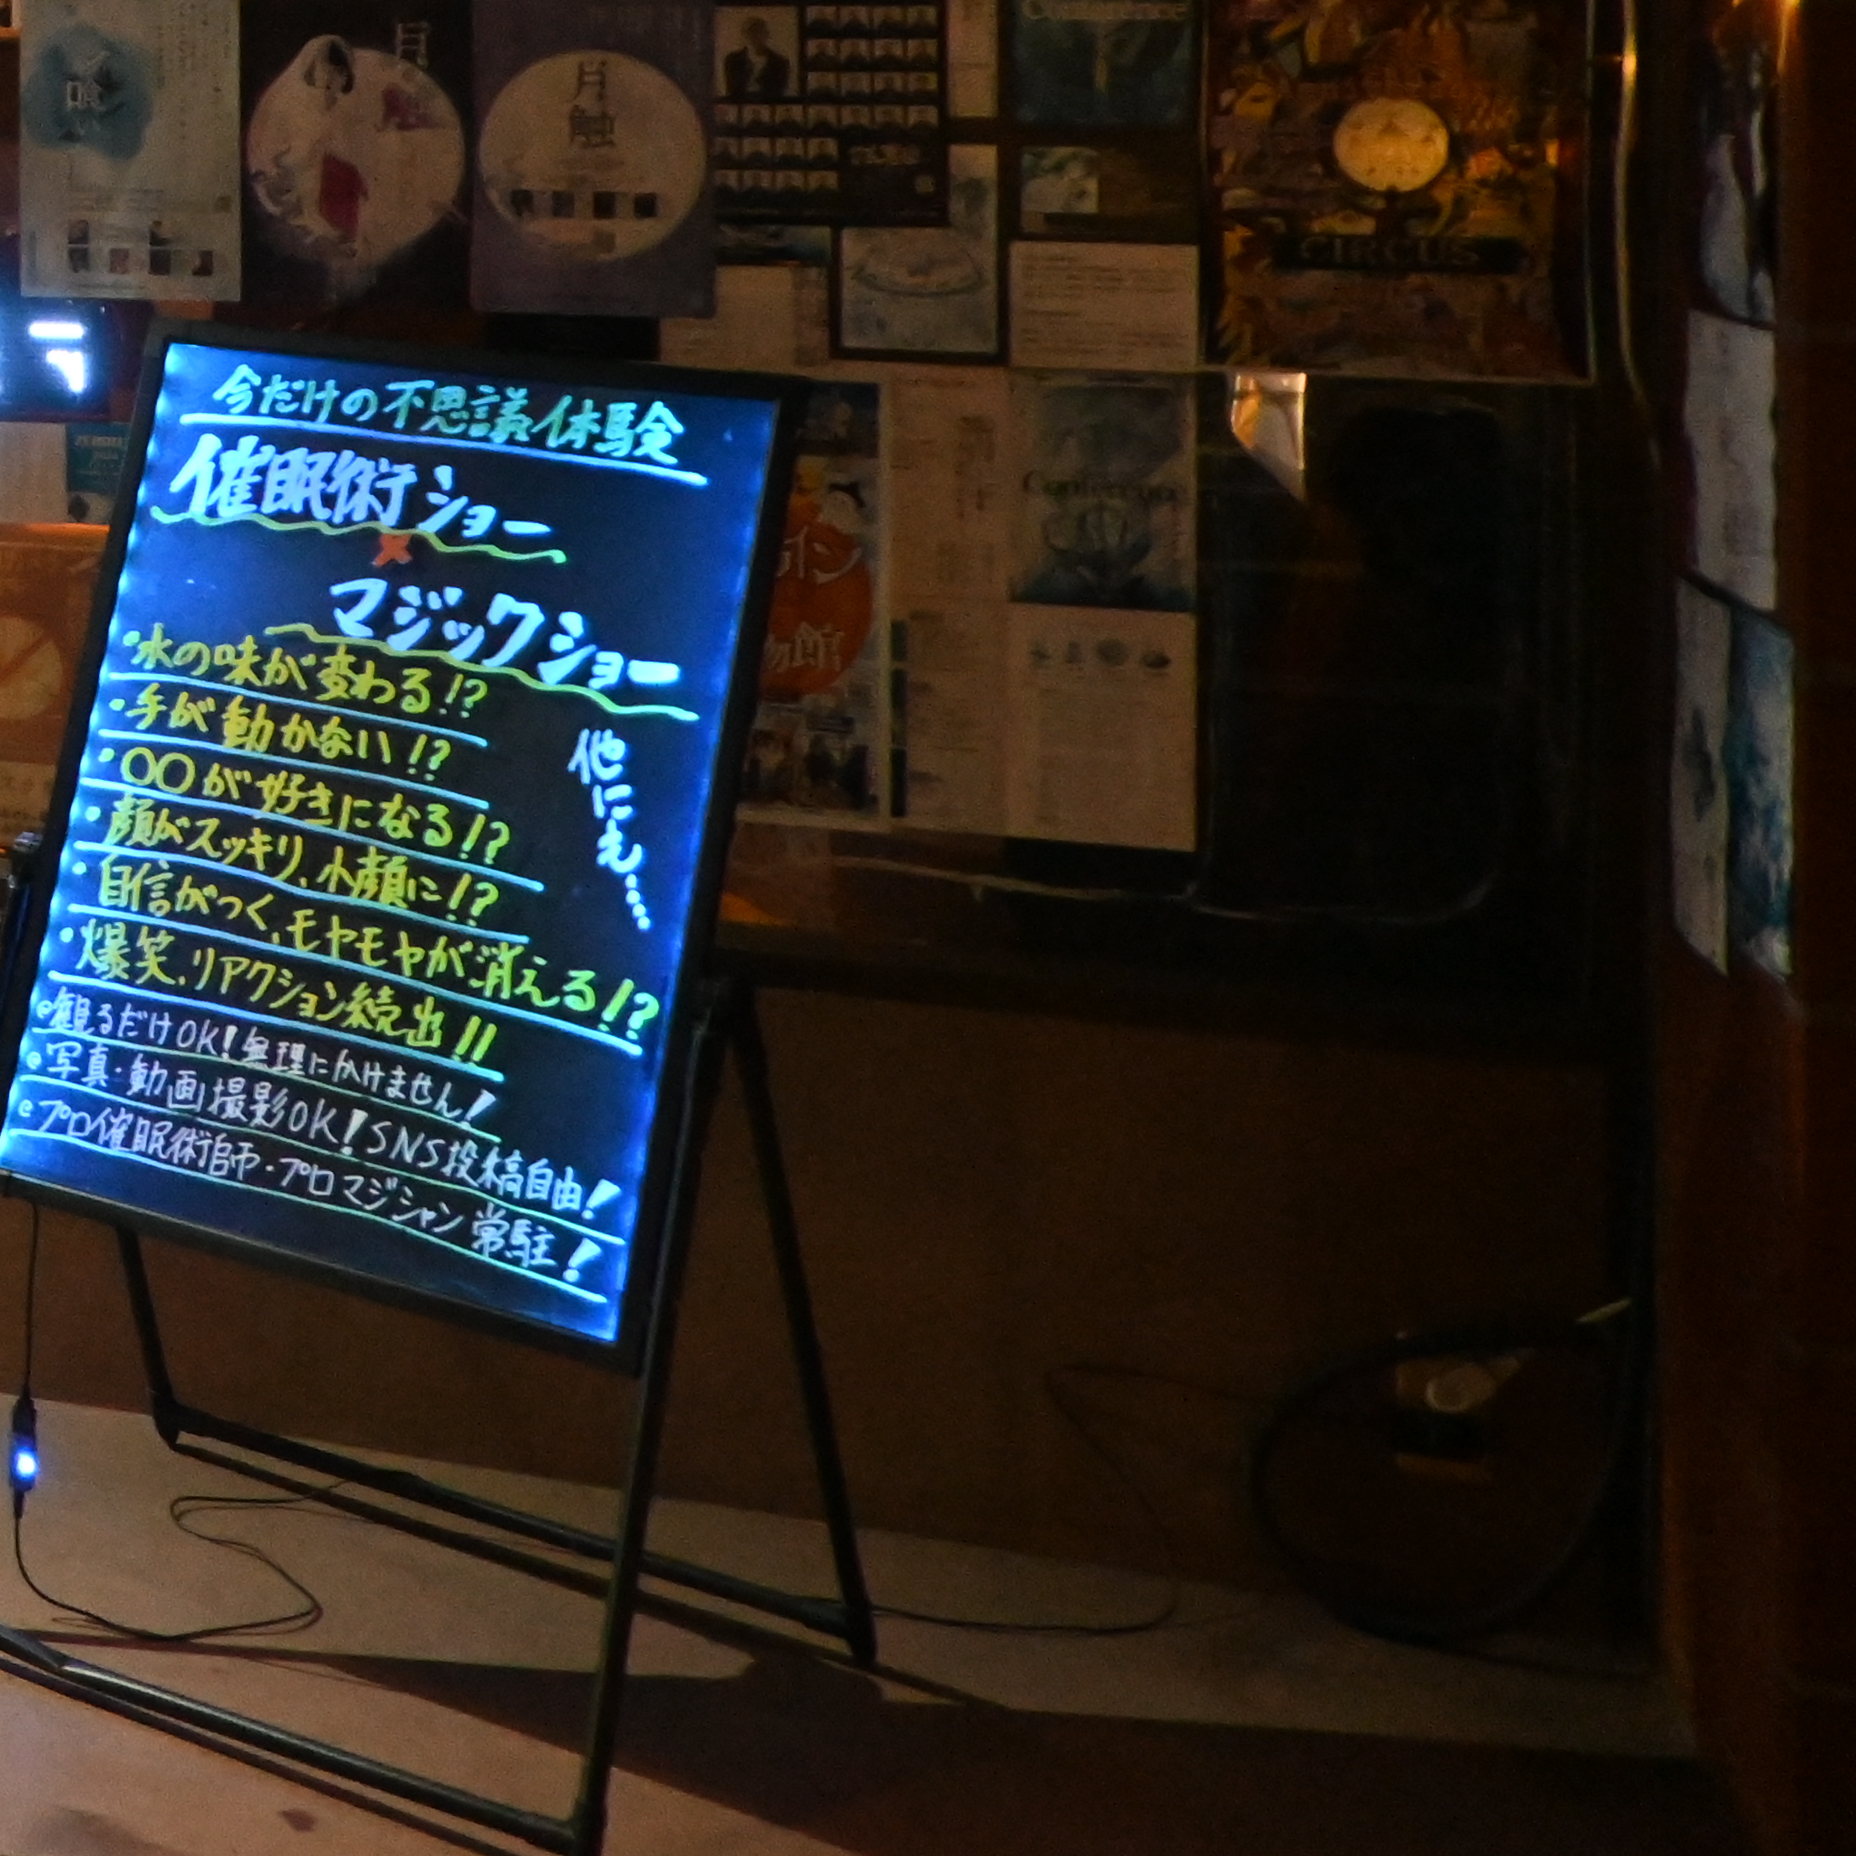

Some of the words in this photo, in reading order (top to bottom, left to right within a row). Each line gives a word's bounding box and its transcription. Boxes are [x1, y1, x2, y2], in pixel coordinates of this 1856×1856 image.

[213, 364, 684, 465] 今だけの不思議体験
[170, 434, 552, 537] 催眠術ショー
[330, 578, 681, 691] マジックショー
